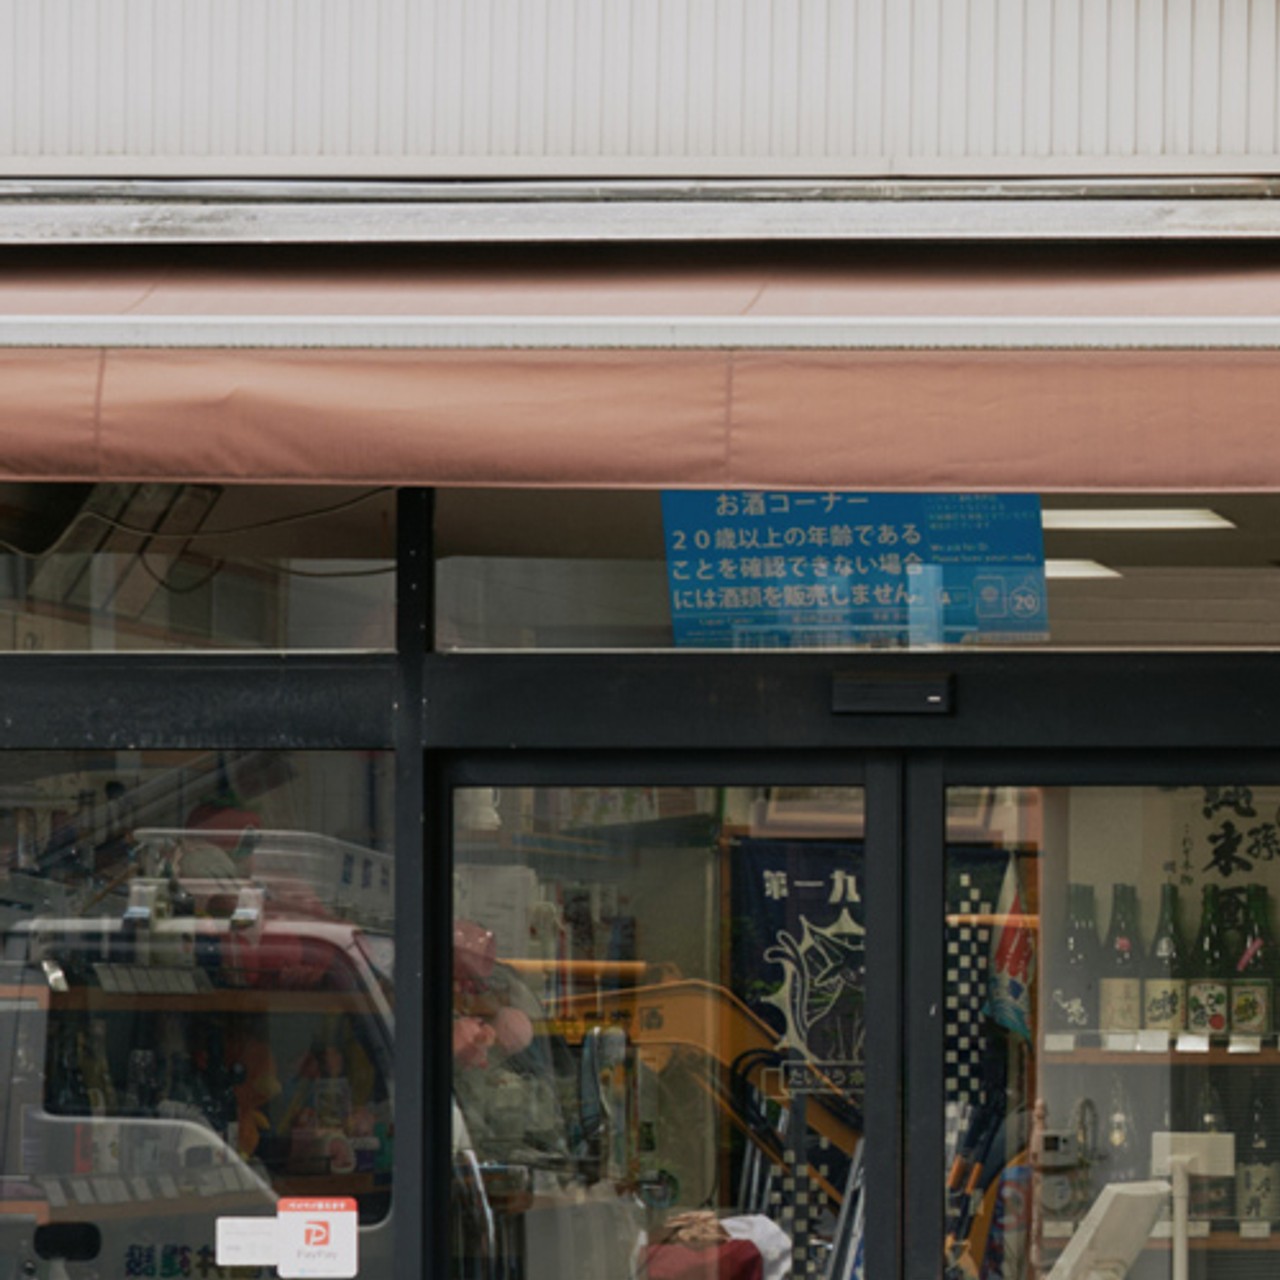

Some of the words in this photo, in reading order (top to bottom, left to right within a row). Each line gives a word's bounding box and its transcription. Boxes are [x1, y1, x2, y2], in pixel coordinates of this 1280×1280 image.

[673, 523, 921, 551] 20歳以上の年齢である
[673, 551, 924, 582] ことを確認できない場合
